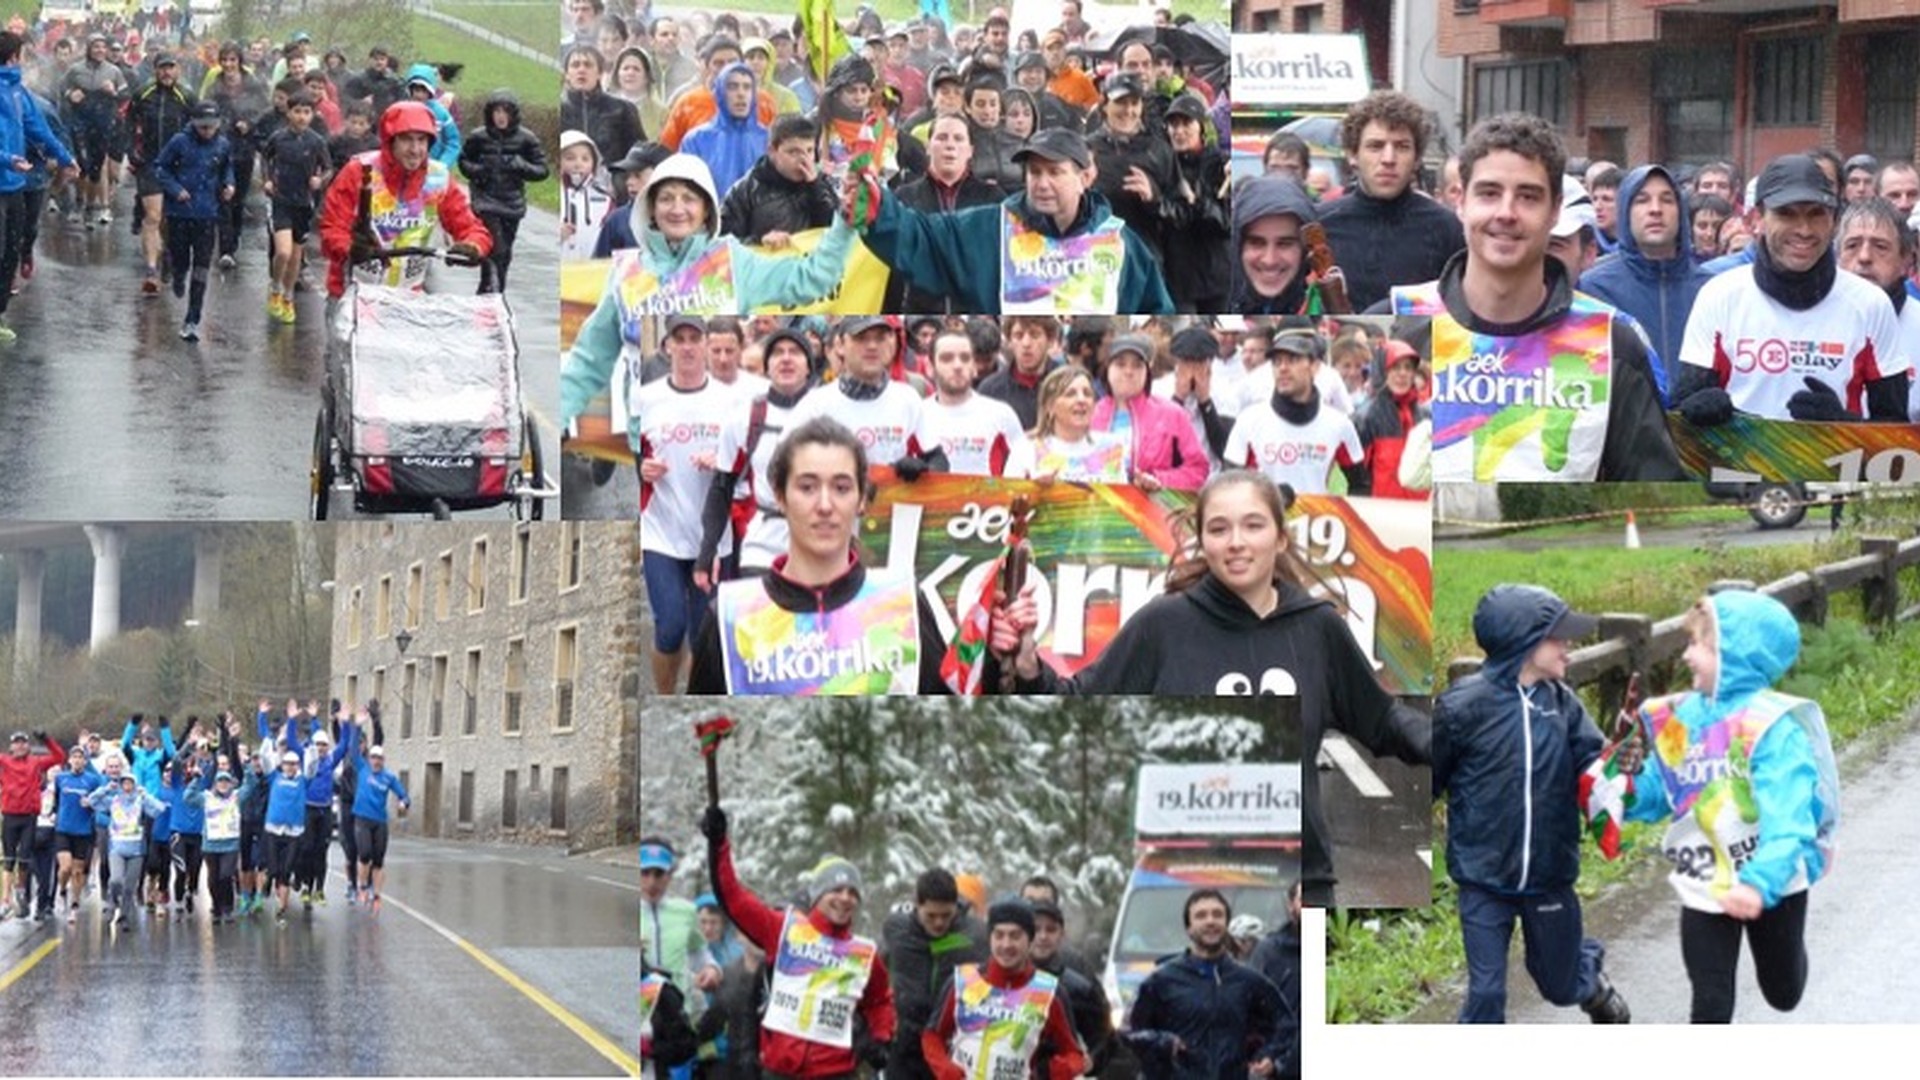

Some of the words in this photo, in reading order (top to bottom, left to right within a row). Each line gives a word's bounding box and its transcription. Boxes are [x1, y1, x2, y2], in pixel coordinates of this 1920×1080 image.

[1465, 346, 1509, 374] aek
[1791, 353, 1843, 371] elay
[1158, 782, 1300, 811] 19.korrika
